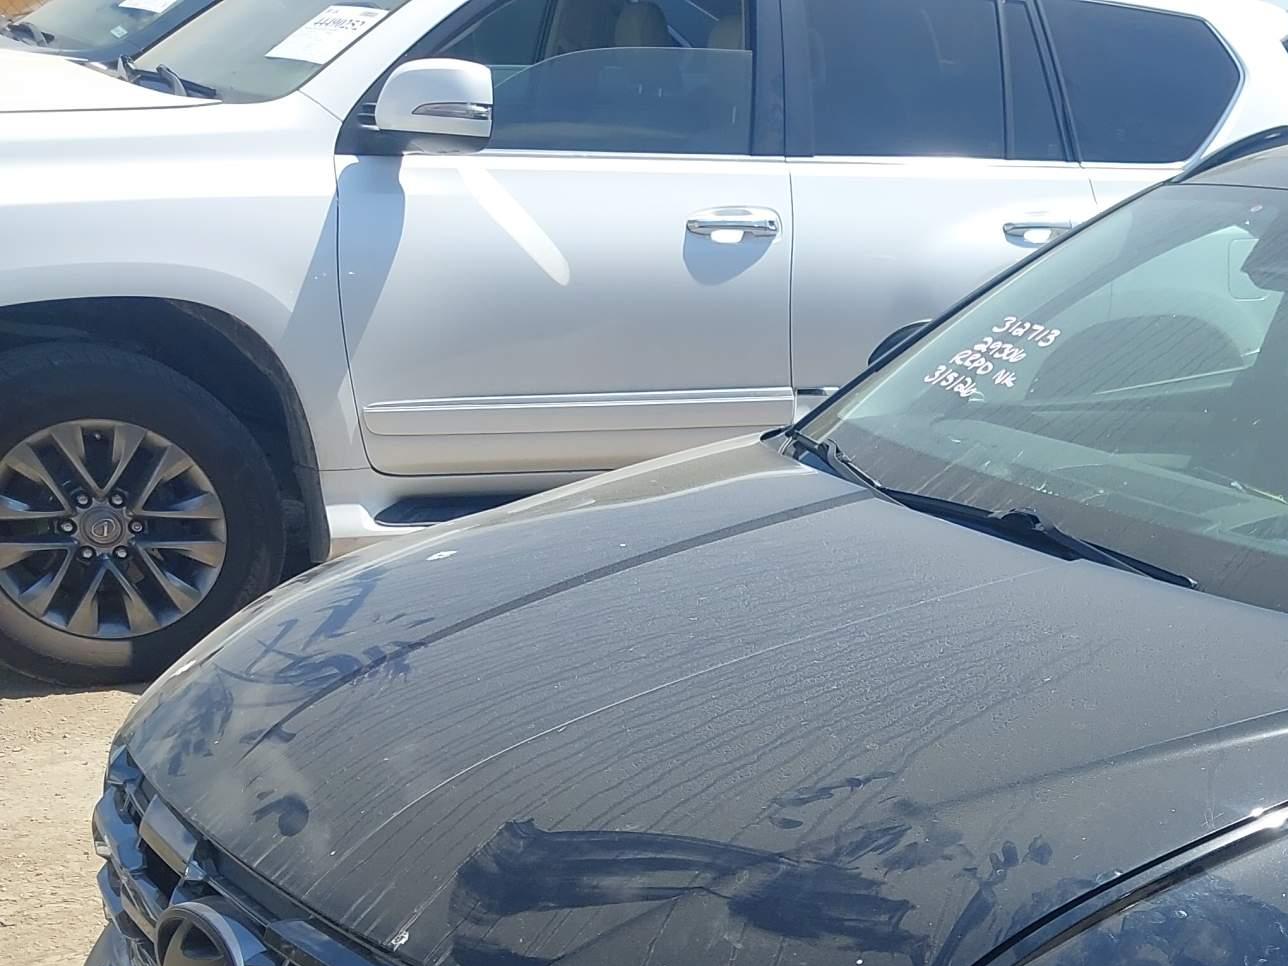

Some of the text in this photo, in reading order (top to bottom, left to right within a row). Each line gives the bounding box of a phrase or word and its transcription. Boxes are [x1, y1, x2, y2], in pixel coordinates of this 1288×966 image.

[992, 316, 1060, 347] 312713
[974, 336, 1026, 362] 29306
[924, 365, 976, 397] 3/5/26
